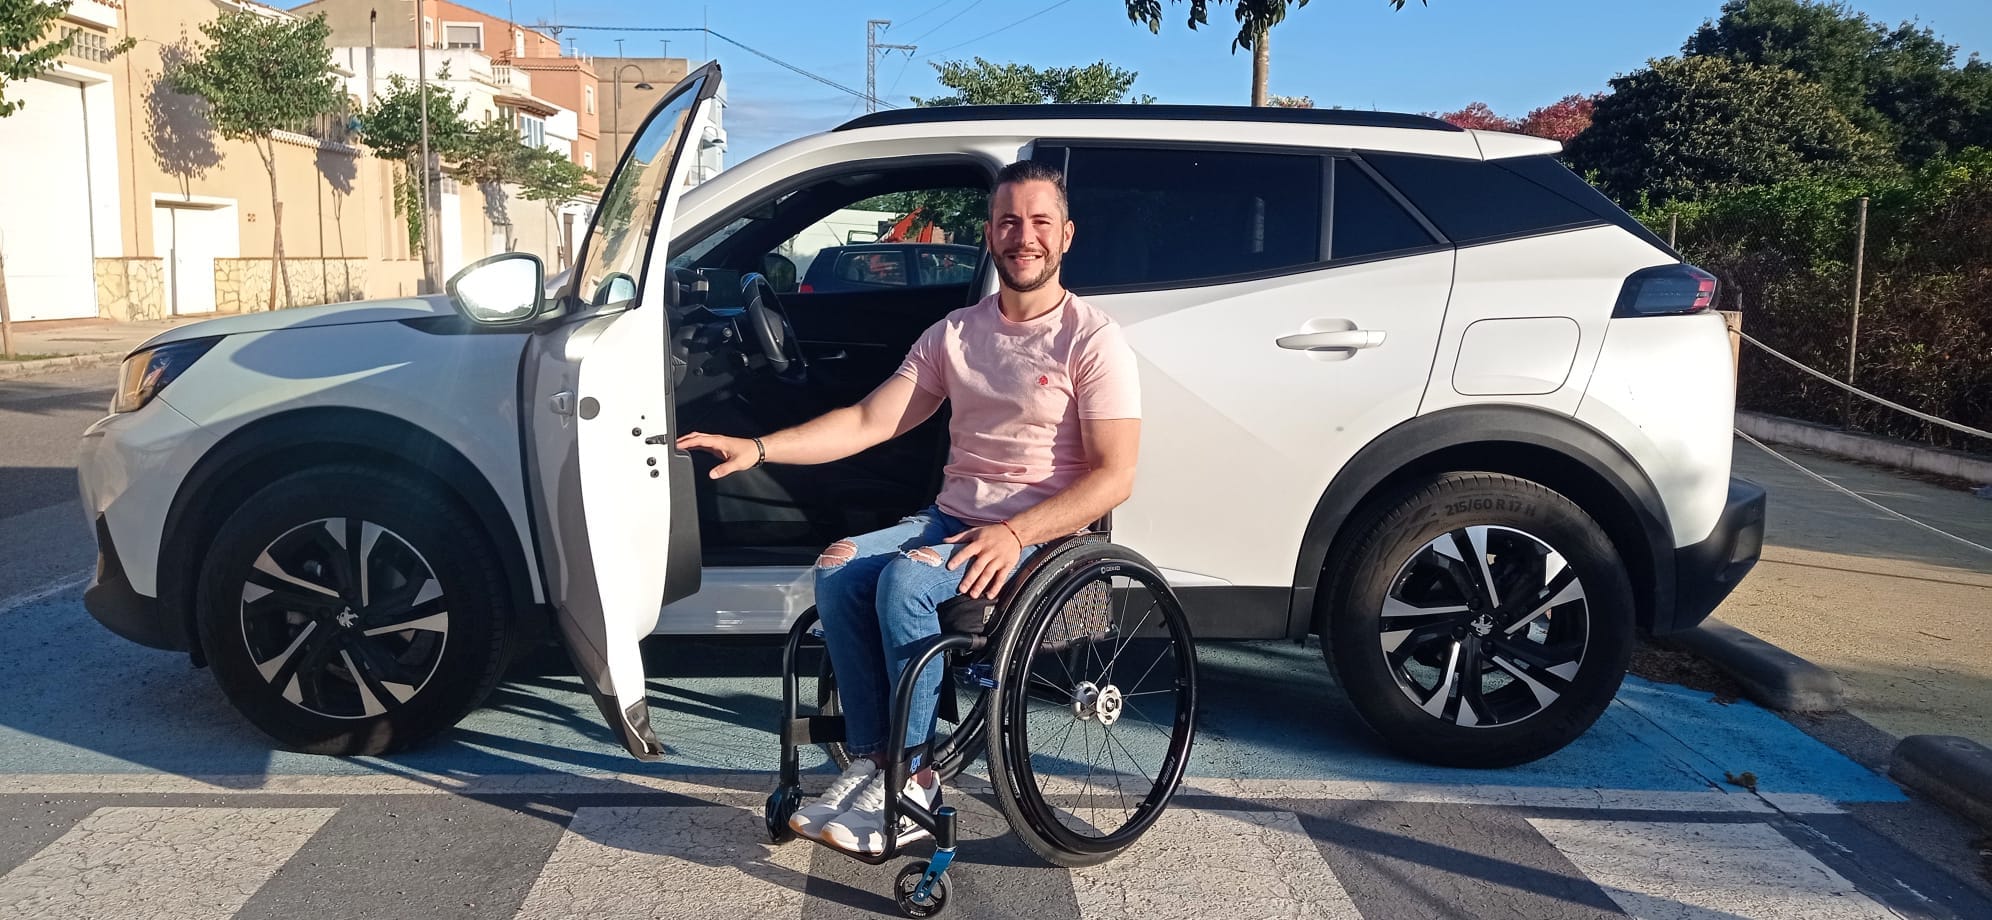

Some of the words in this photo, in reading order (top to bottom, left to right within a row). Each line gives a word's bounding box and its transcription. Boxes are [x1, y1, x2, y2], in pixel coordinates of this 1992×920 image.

[1445, 499, 1493, 516] 215/60
[1496, 499, 1505, 511] R
[1508, 501, 1521, 512] 17
